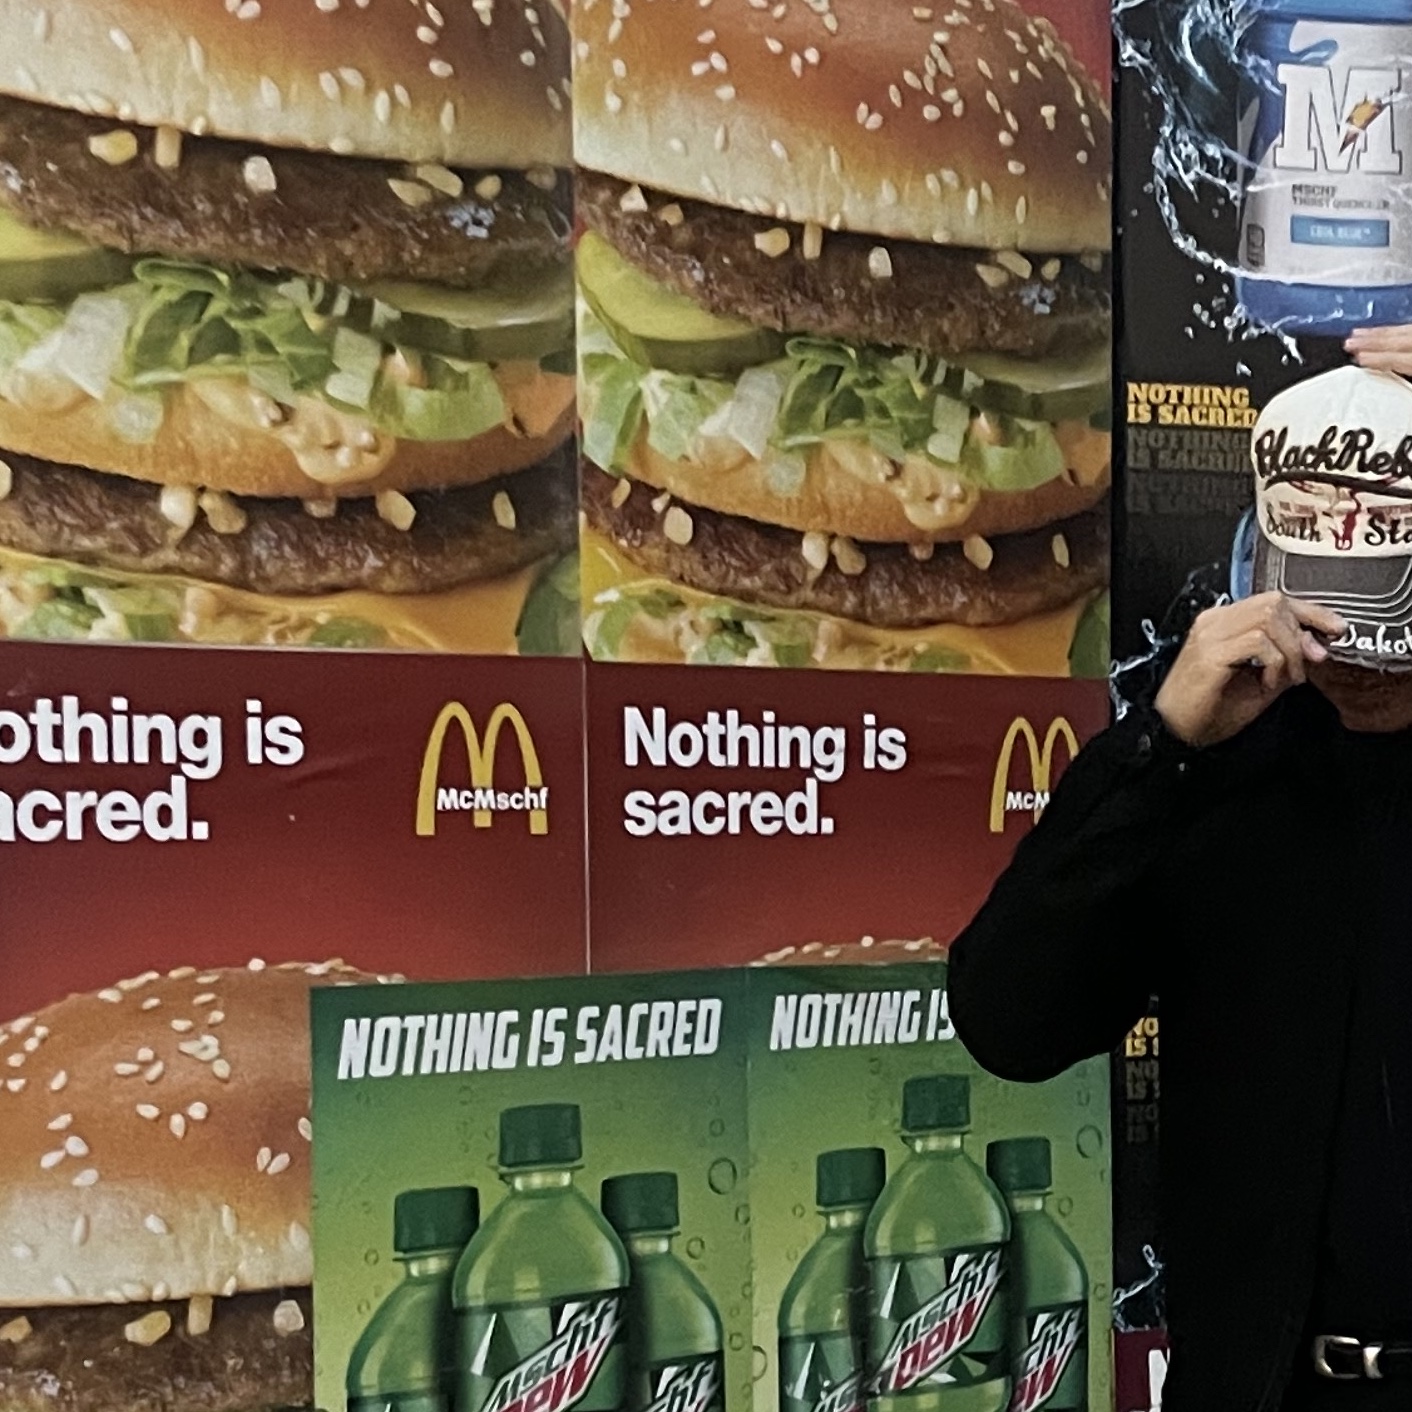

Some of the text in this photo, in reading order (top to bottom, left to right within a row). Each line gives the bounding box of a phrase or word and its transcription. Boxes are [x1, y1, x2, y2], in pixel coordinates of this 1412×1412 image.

[1127, 382, 1249, 408] NOTHING
[1127, 403, 1151, 423] IS
[1266, 502, 1322, 543] South
[0, 696, 304, 780] othing is
[624, 707, 907, 782] Nothing is
[0, 775, 209, 842] cred.
[437, 786, 549, 811] McMschf
[624, 779, 834, 836] sacred.
[337, 998, 722, 1080] NOTHING IS SACRED
[770, 989, 921, 1050] NOTHING
